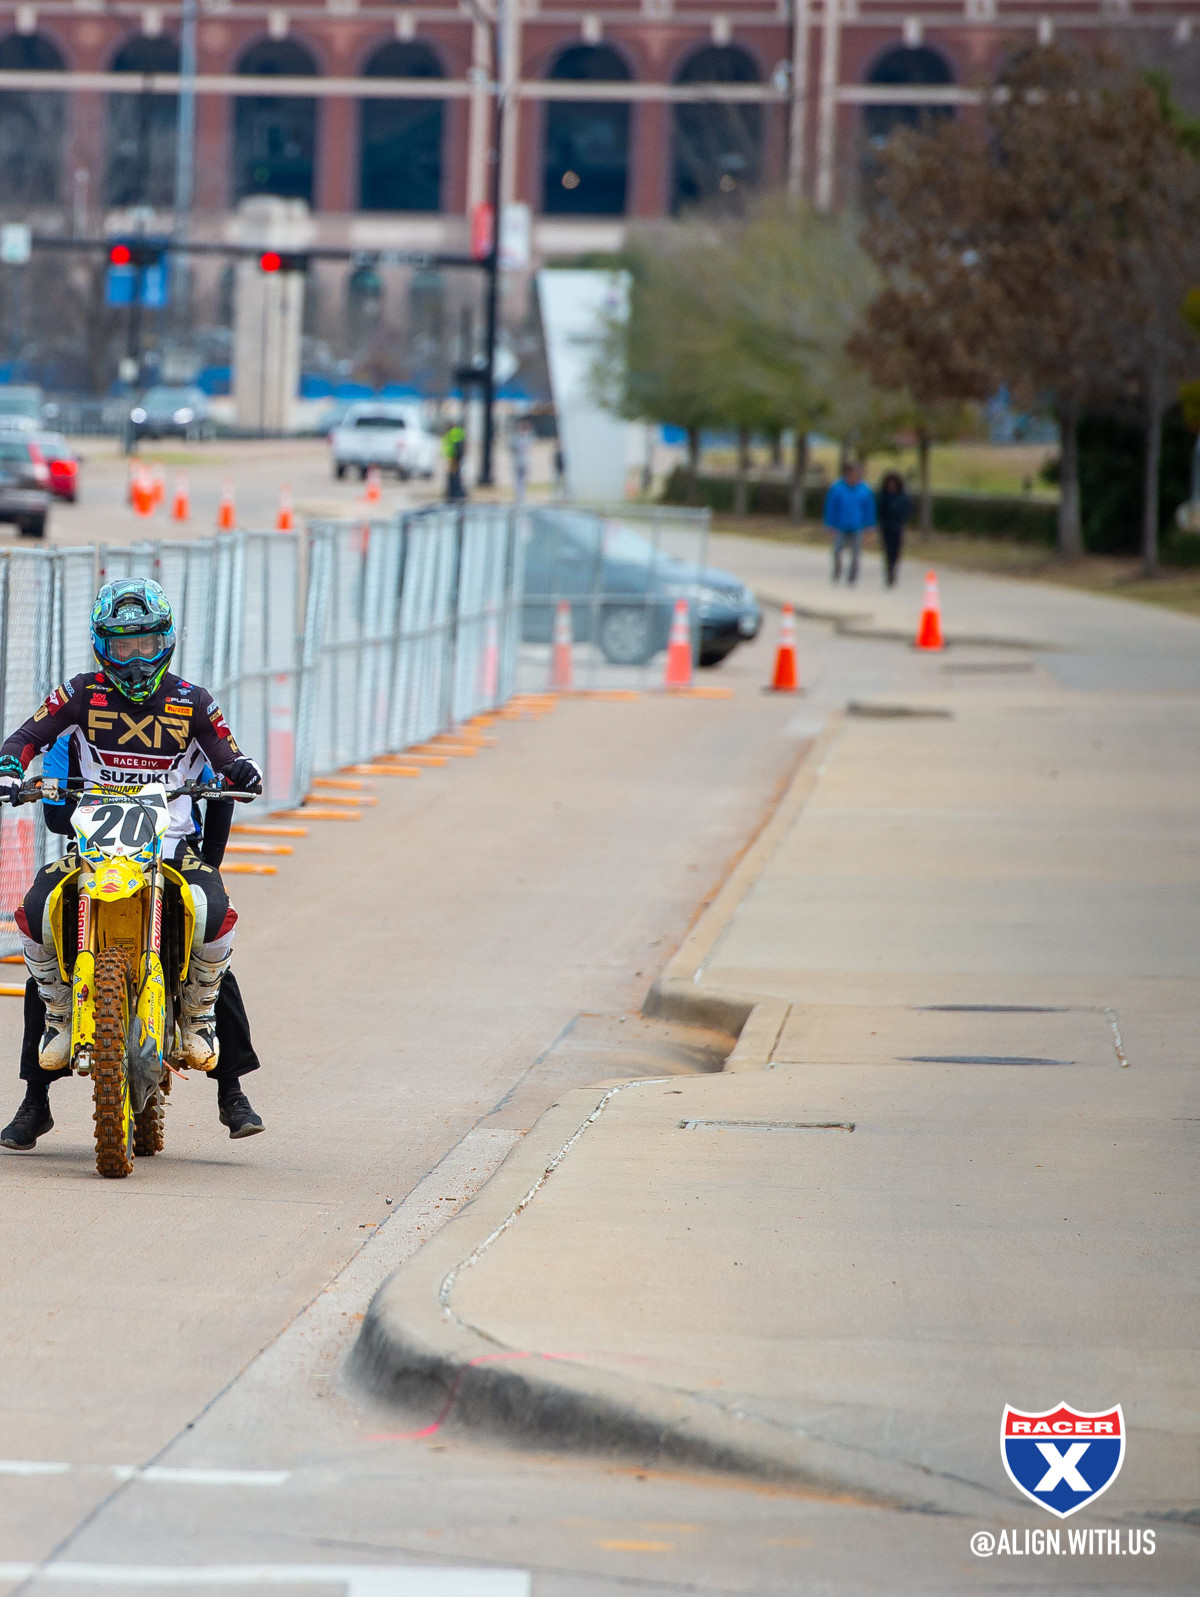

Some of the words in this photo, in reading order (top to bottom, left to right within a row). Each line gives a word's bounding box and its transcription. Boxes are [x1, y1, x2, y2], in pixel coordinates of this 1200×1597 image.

[88, 709, 190, 750] FXR
[113, 757, 139, 766] RACE
[100, 769, 170, 784] SUZUKI
[87, 804, 158, 849] 20
